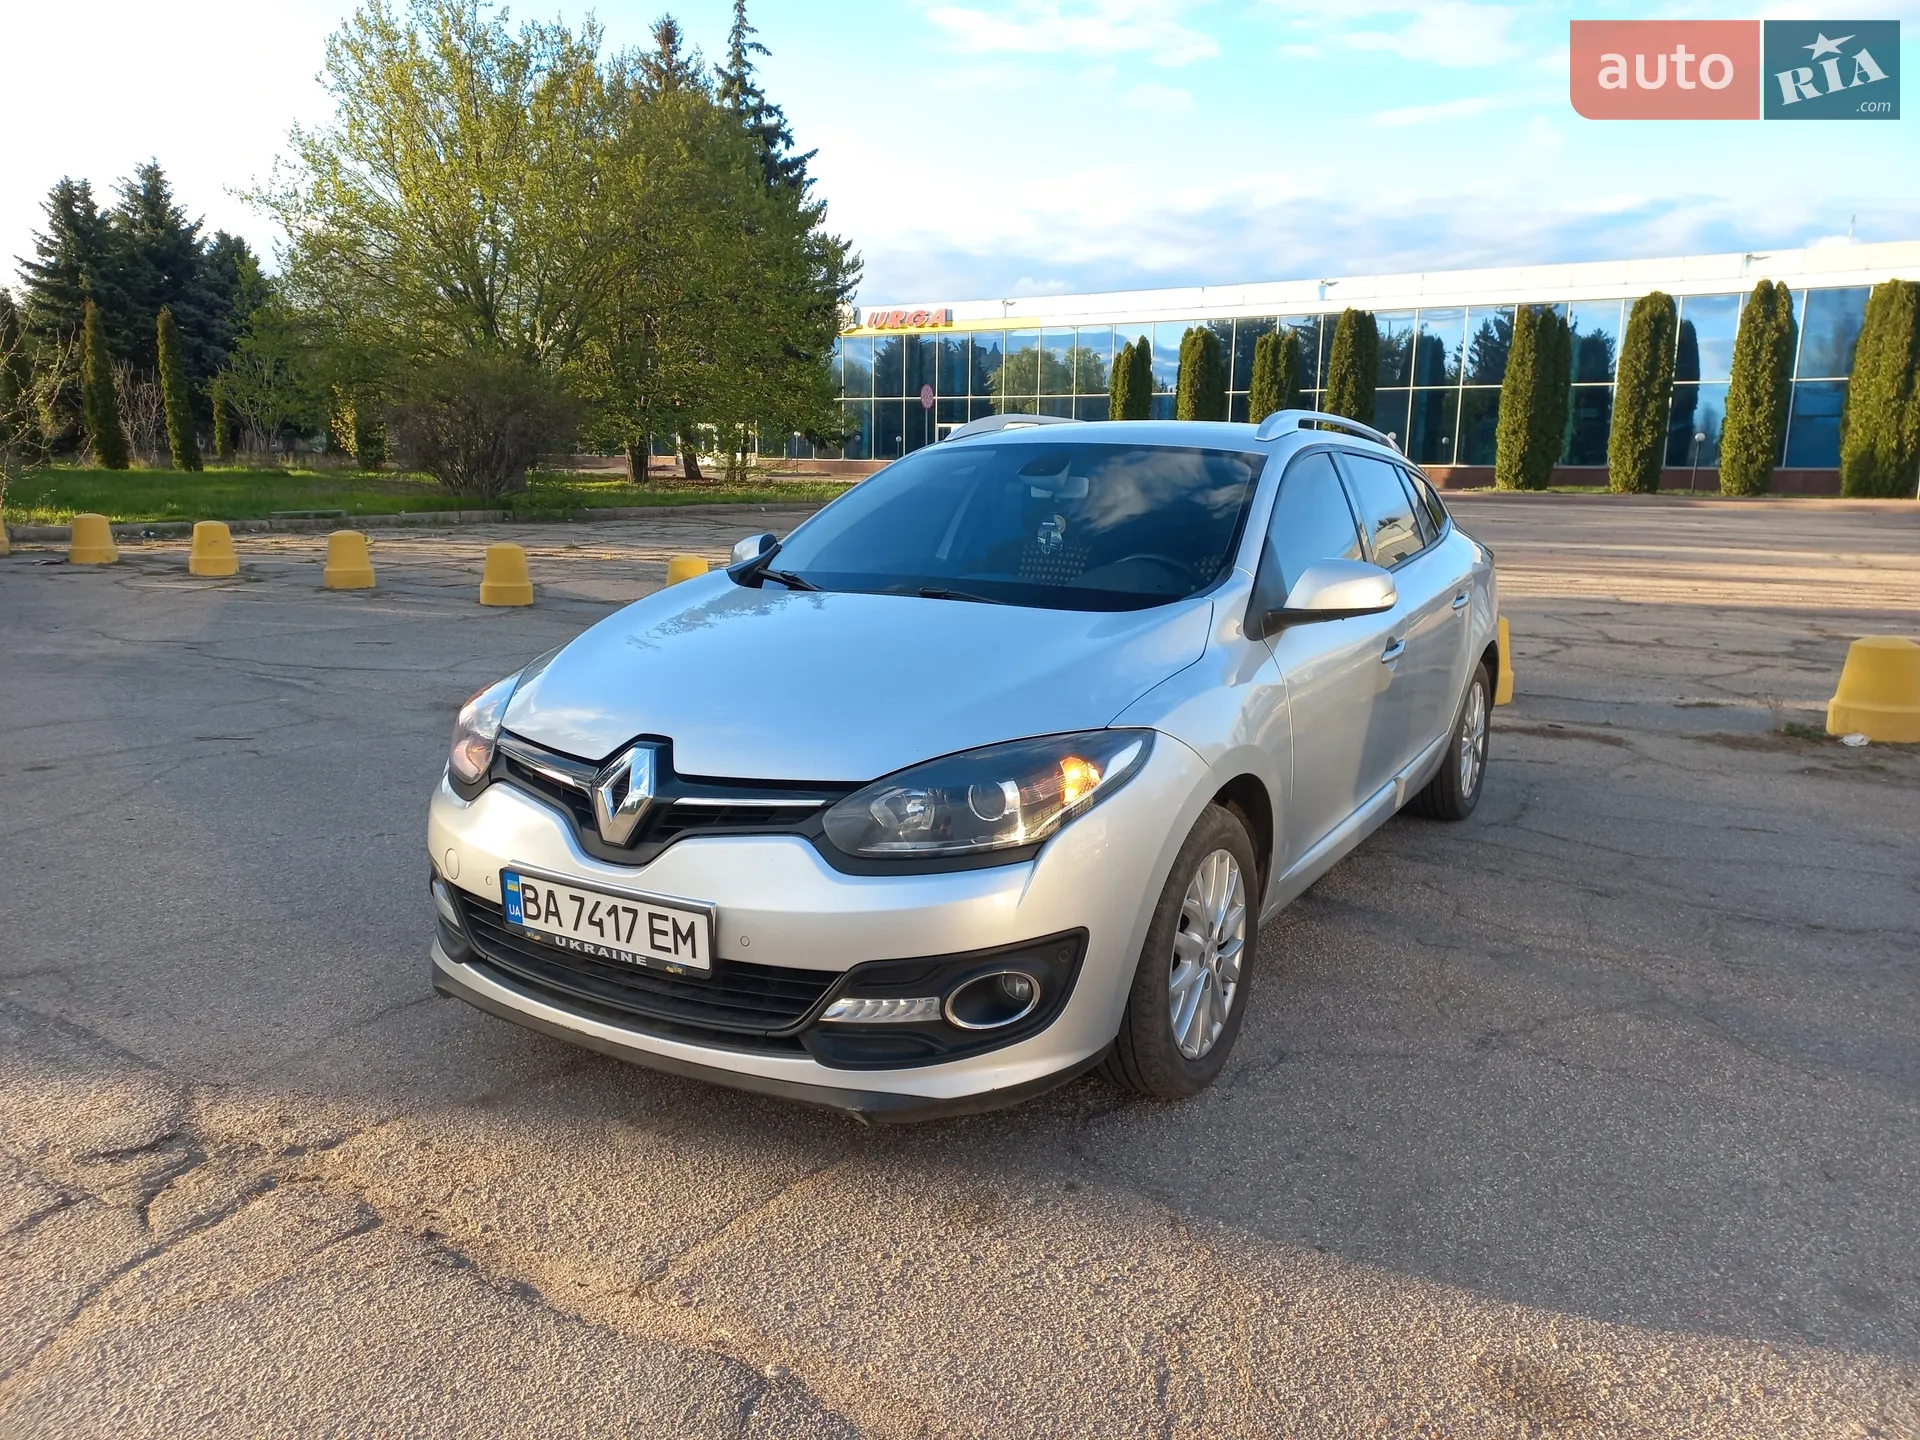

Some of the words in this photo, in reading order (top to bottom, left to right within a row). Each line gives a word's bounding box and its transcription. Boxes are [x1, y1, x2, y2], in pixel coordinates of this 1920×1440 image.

[867, 308, 948, 329] URGA
[509, 903, 521, 918] UA
[520, 882, 563, 928] BA
[568, 894, 639, 944] 7417
[647, 911, 697, 959] EM
[554, 936, 647, 966] UKRAINE
